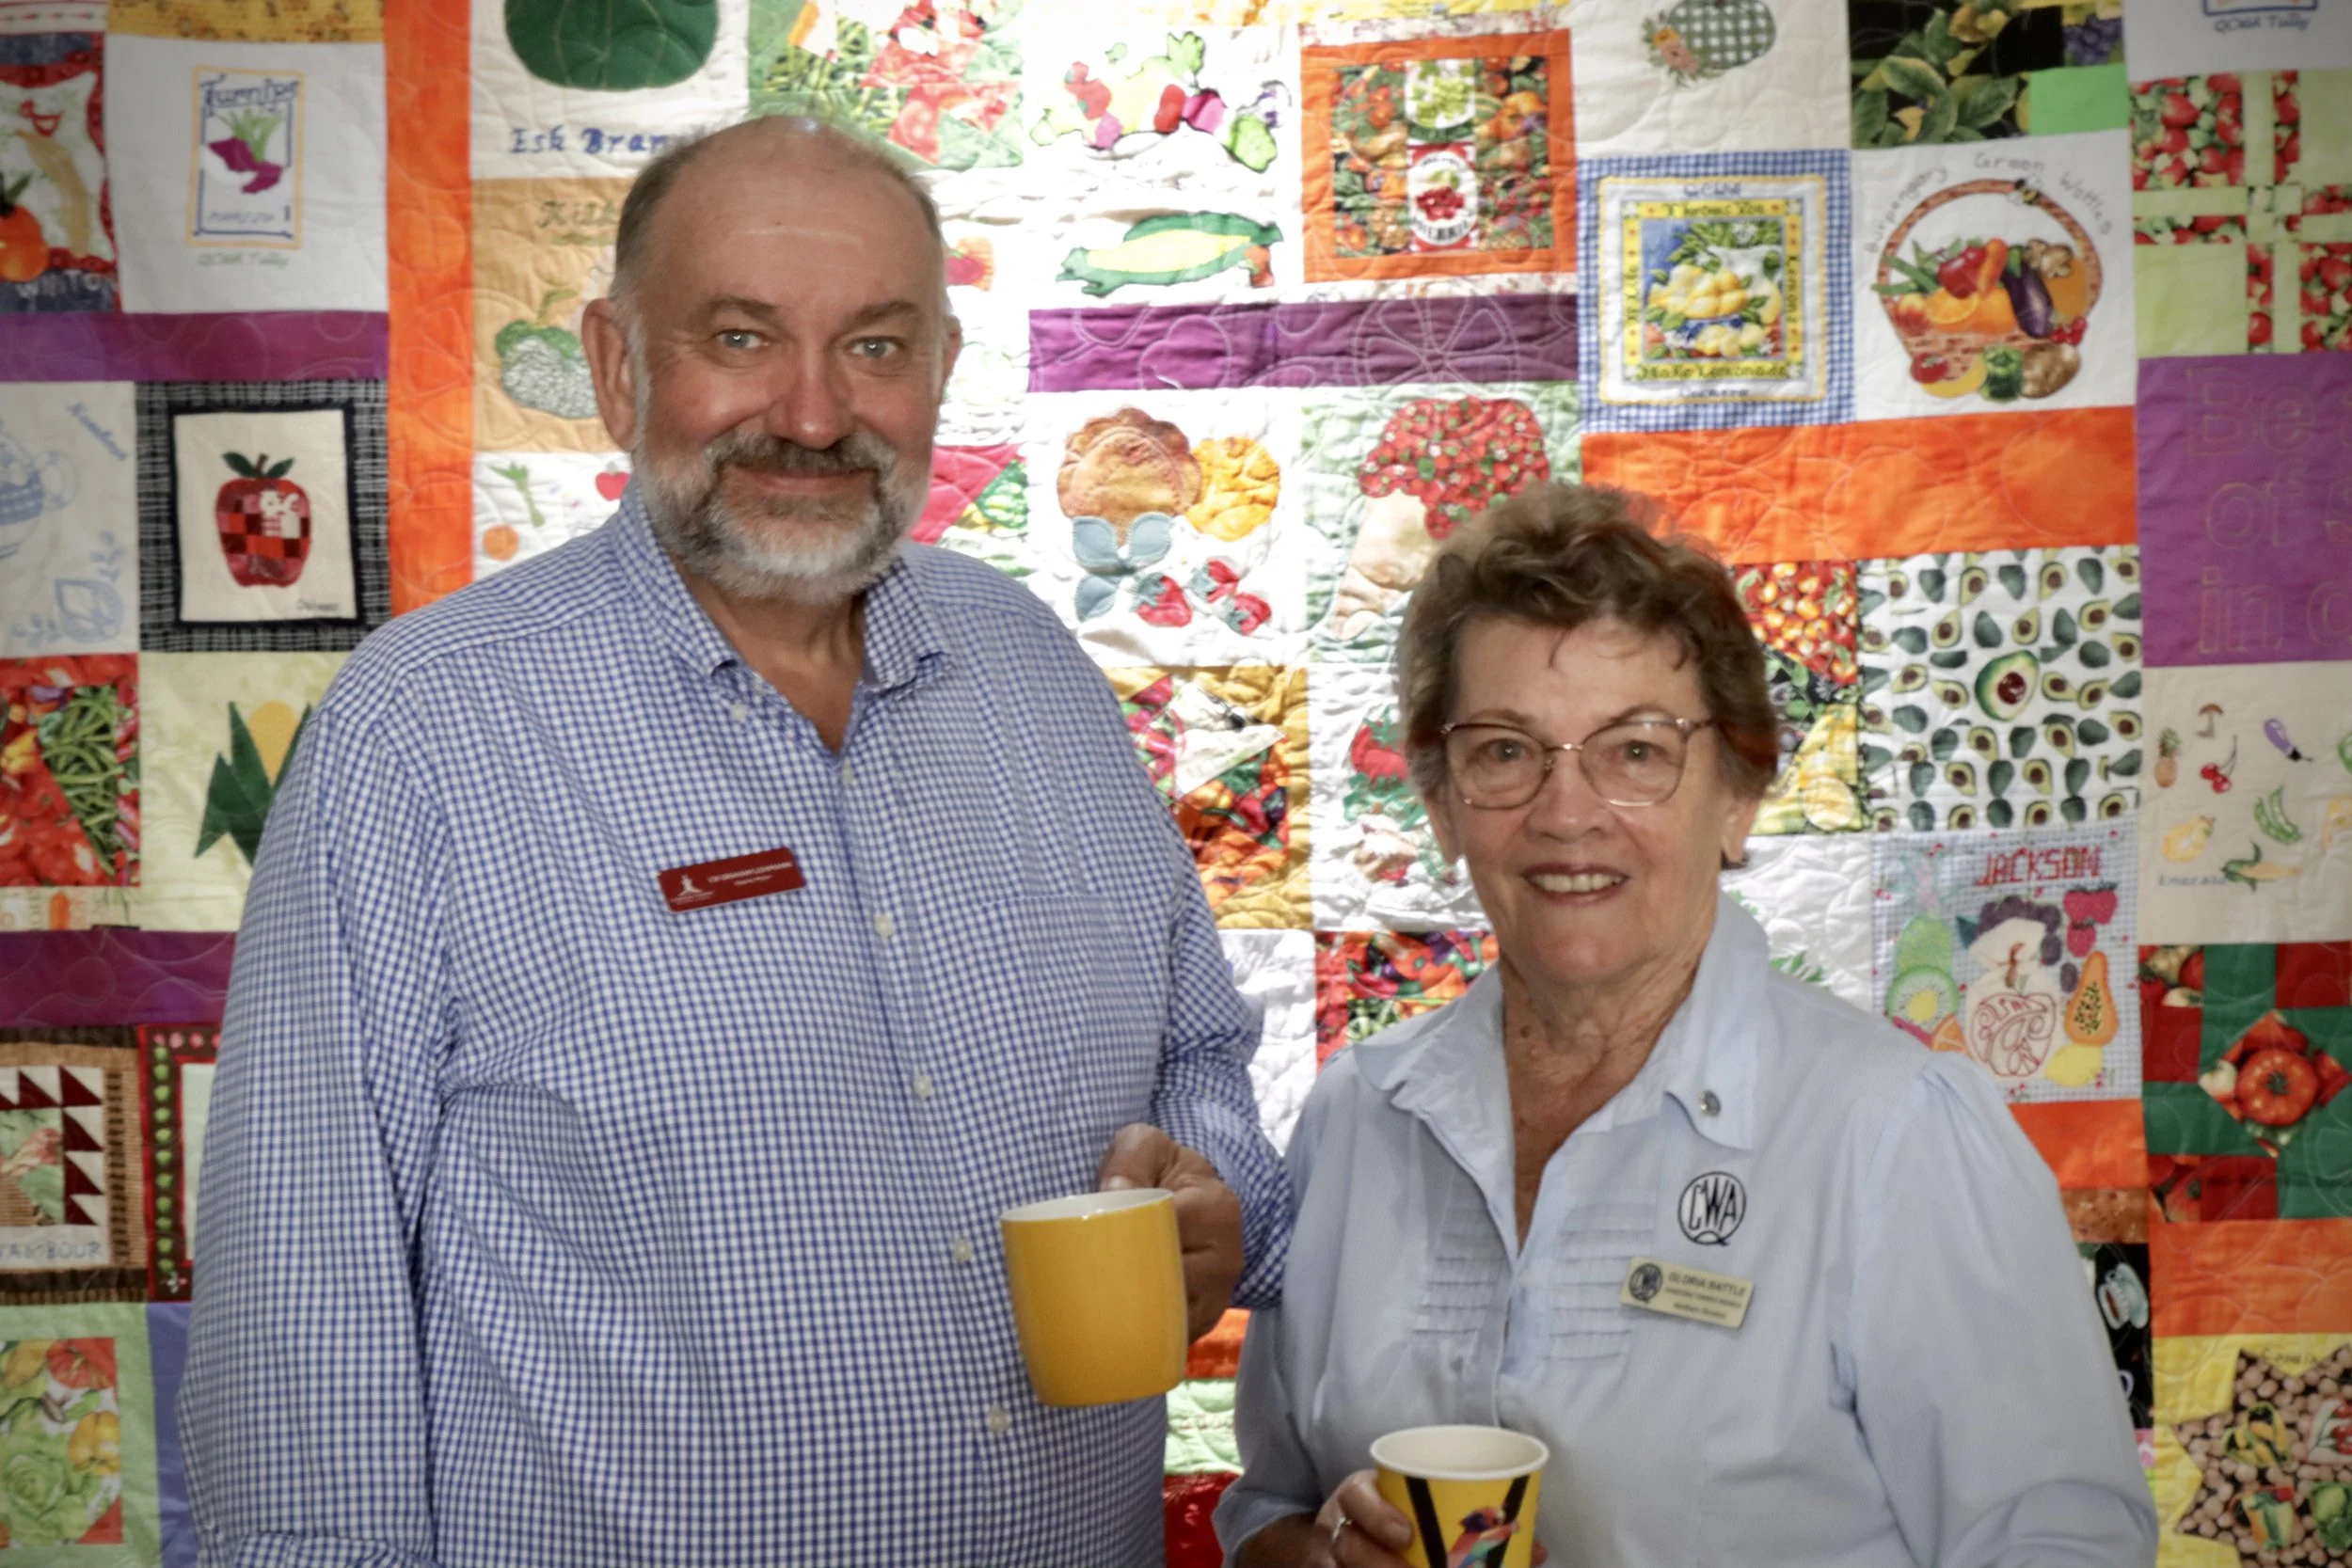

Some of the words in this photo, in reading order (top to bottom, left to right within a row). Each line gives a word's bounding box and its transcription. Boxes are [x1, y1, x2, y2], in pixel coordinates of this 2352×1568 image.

[510, 124, 565, 154] Esk
[1973, 151, 2046, 172] Green
[1972, 844, 2102, 887] JACKSON
[1668, 1271, 1707, 1288] GLORIA
[1708, 1279, 1747, 1298] BATTLE
